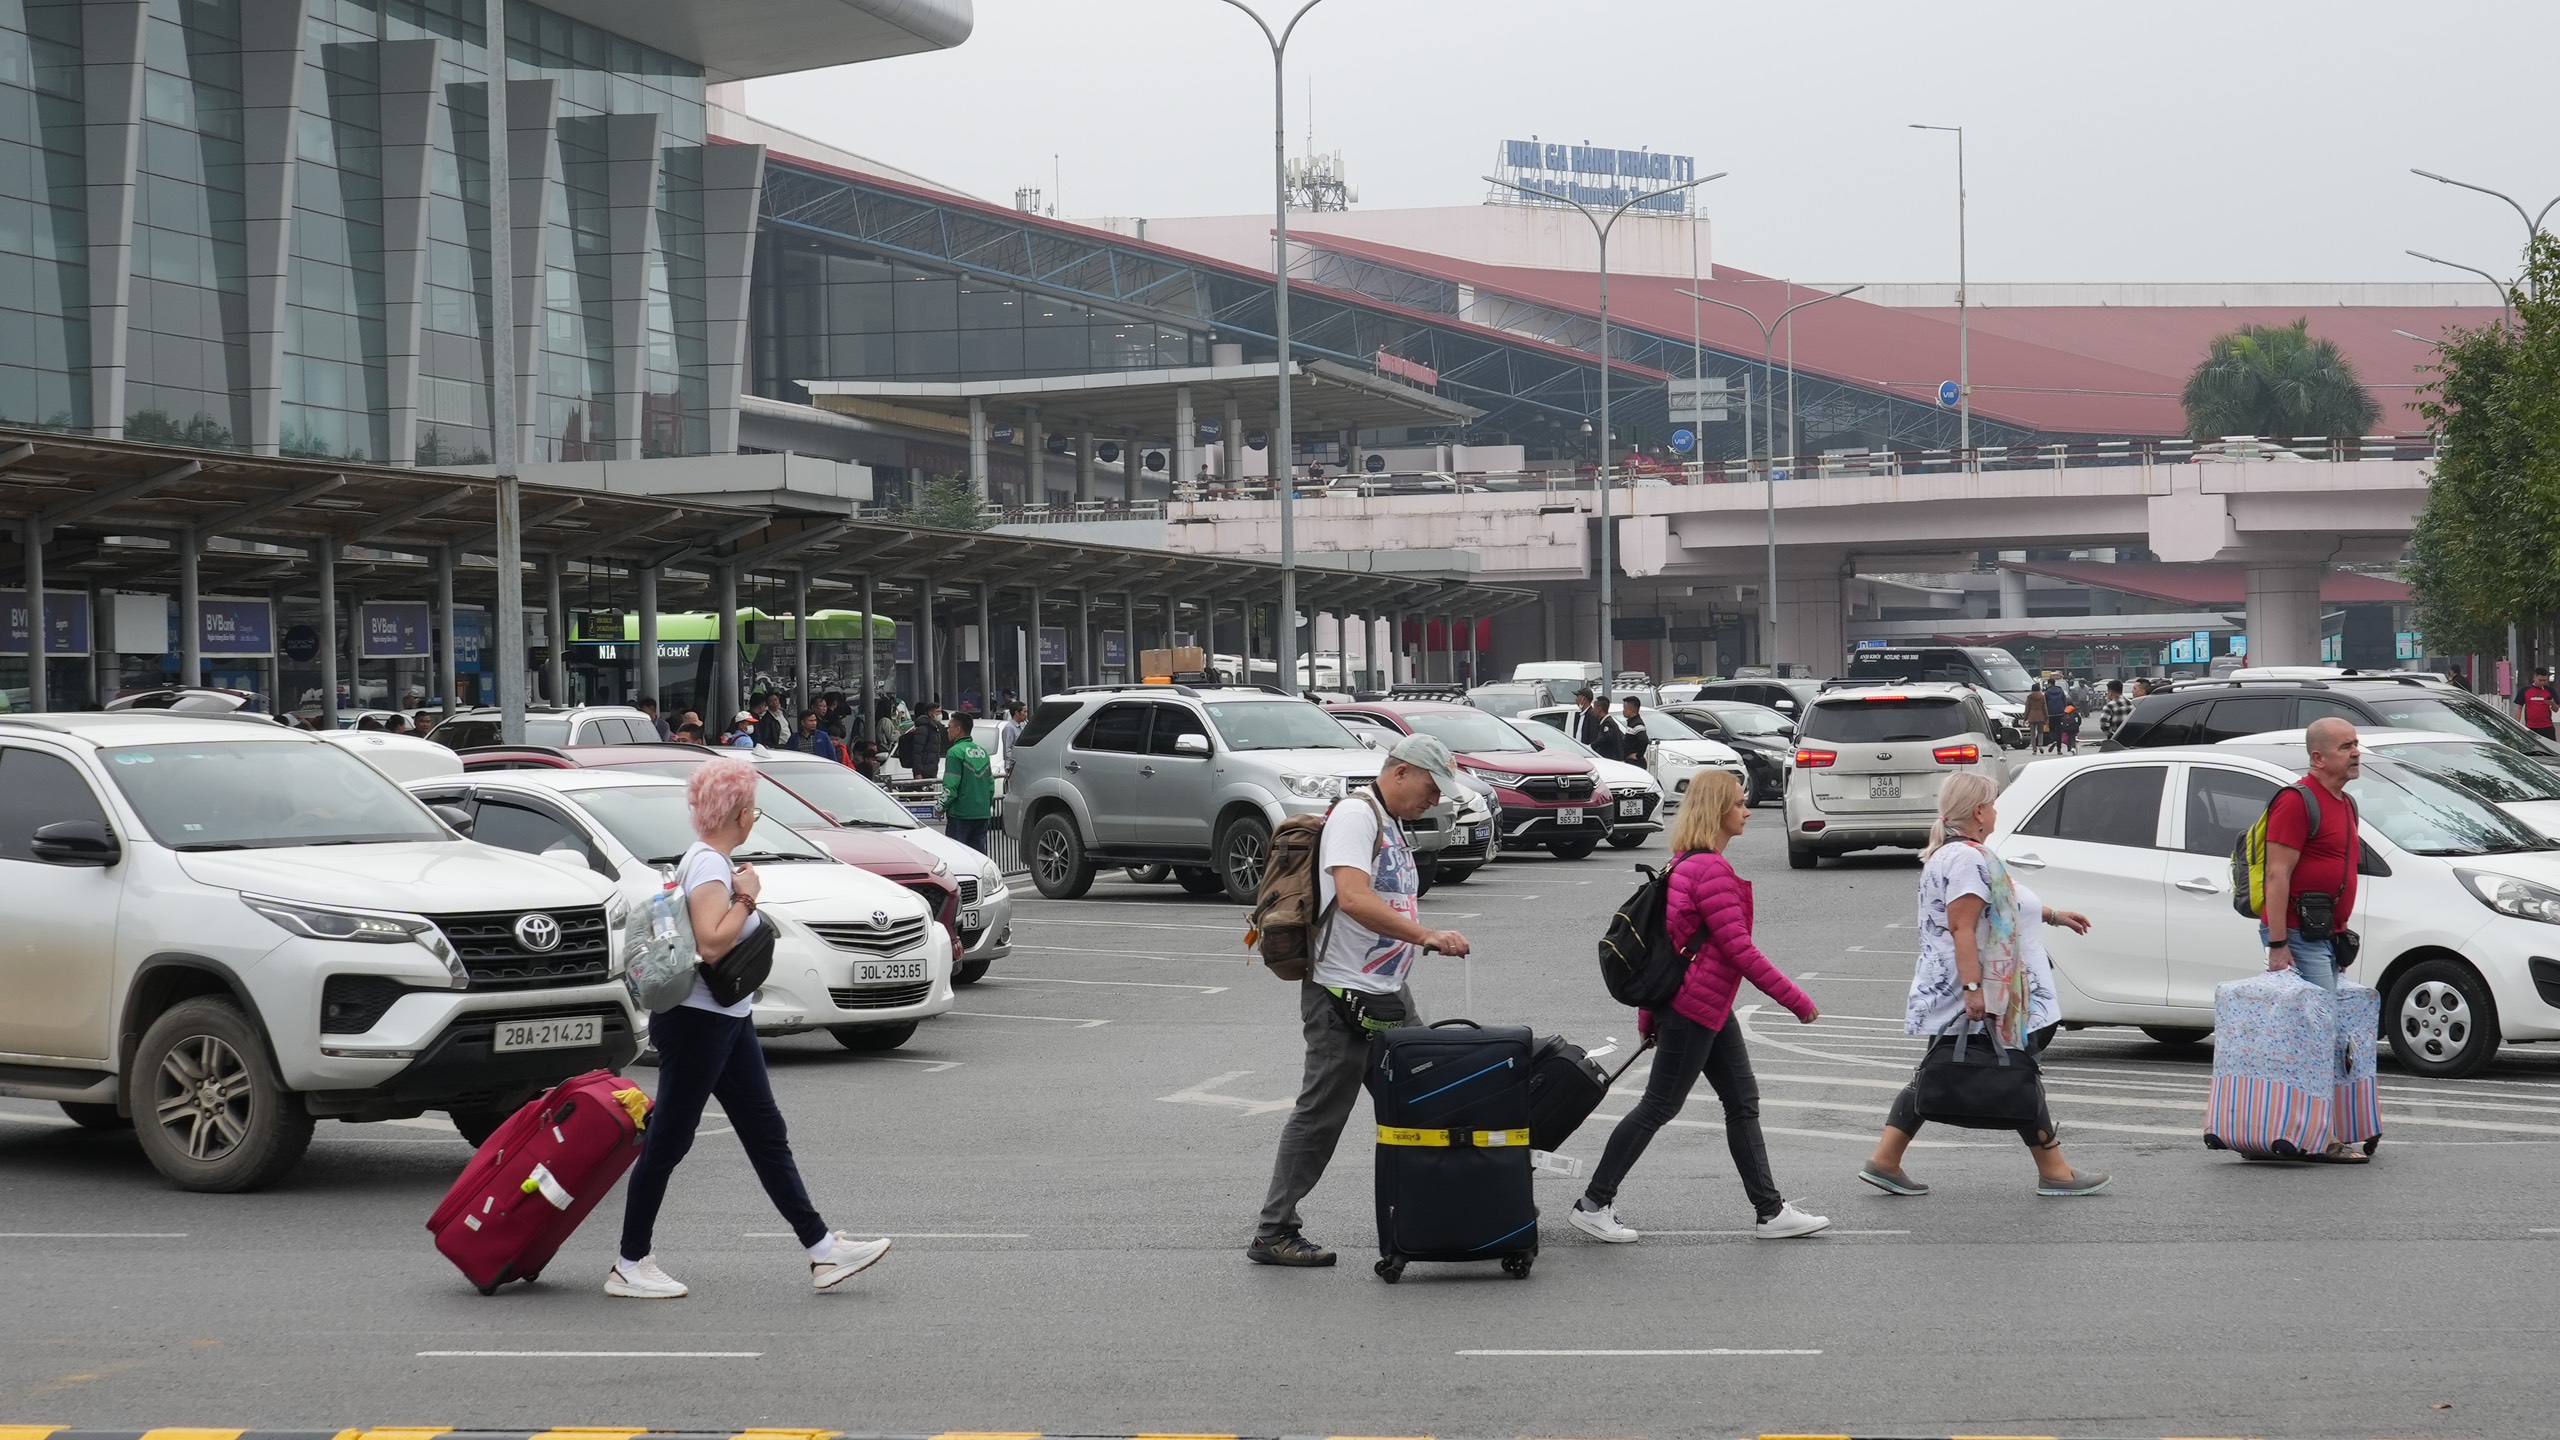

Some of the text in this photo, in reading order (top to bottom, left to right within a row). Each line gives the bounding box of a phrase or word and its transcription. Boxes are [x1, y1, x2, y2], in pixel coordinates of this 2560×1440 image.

[1546, 144, 1568, 171] GA
[1674, 156, 1694, 181] T1
[206, 614, 235, 631] BVBank
[372, 618, 397, 634] BVBank
[465, 636, 478, 662] E5
[965, 746, 986, 758] Grab
[1877, 777, 1893, 786] 34A
[1871, 787, 1900, 797] 305.88
[1626, 800, 1637, 808] 30H
[1565, 808, 1576, 816] 30H
[1559, 816, 1581, 824] 965.33
[860, 964, 921, 980] 30L-293.65
[504, 1022, 593, 1046] 28A-214.23
